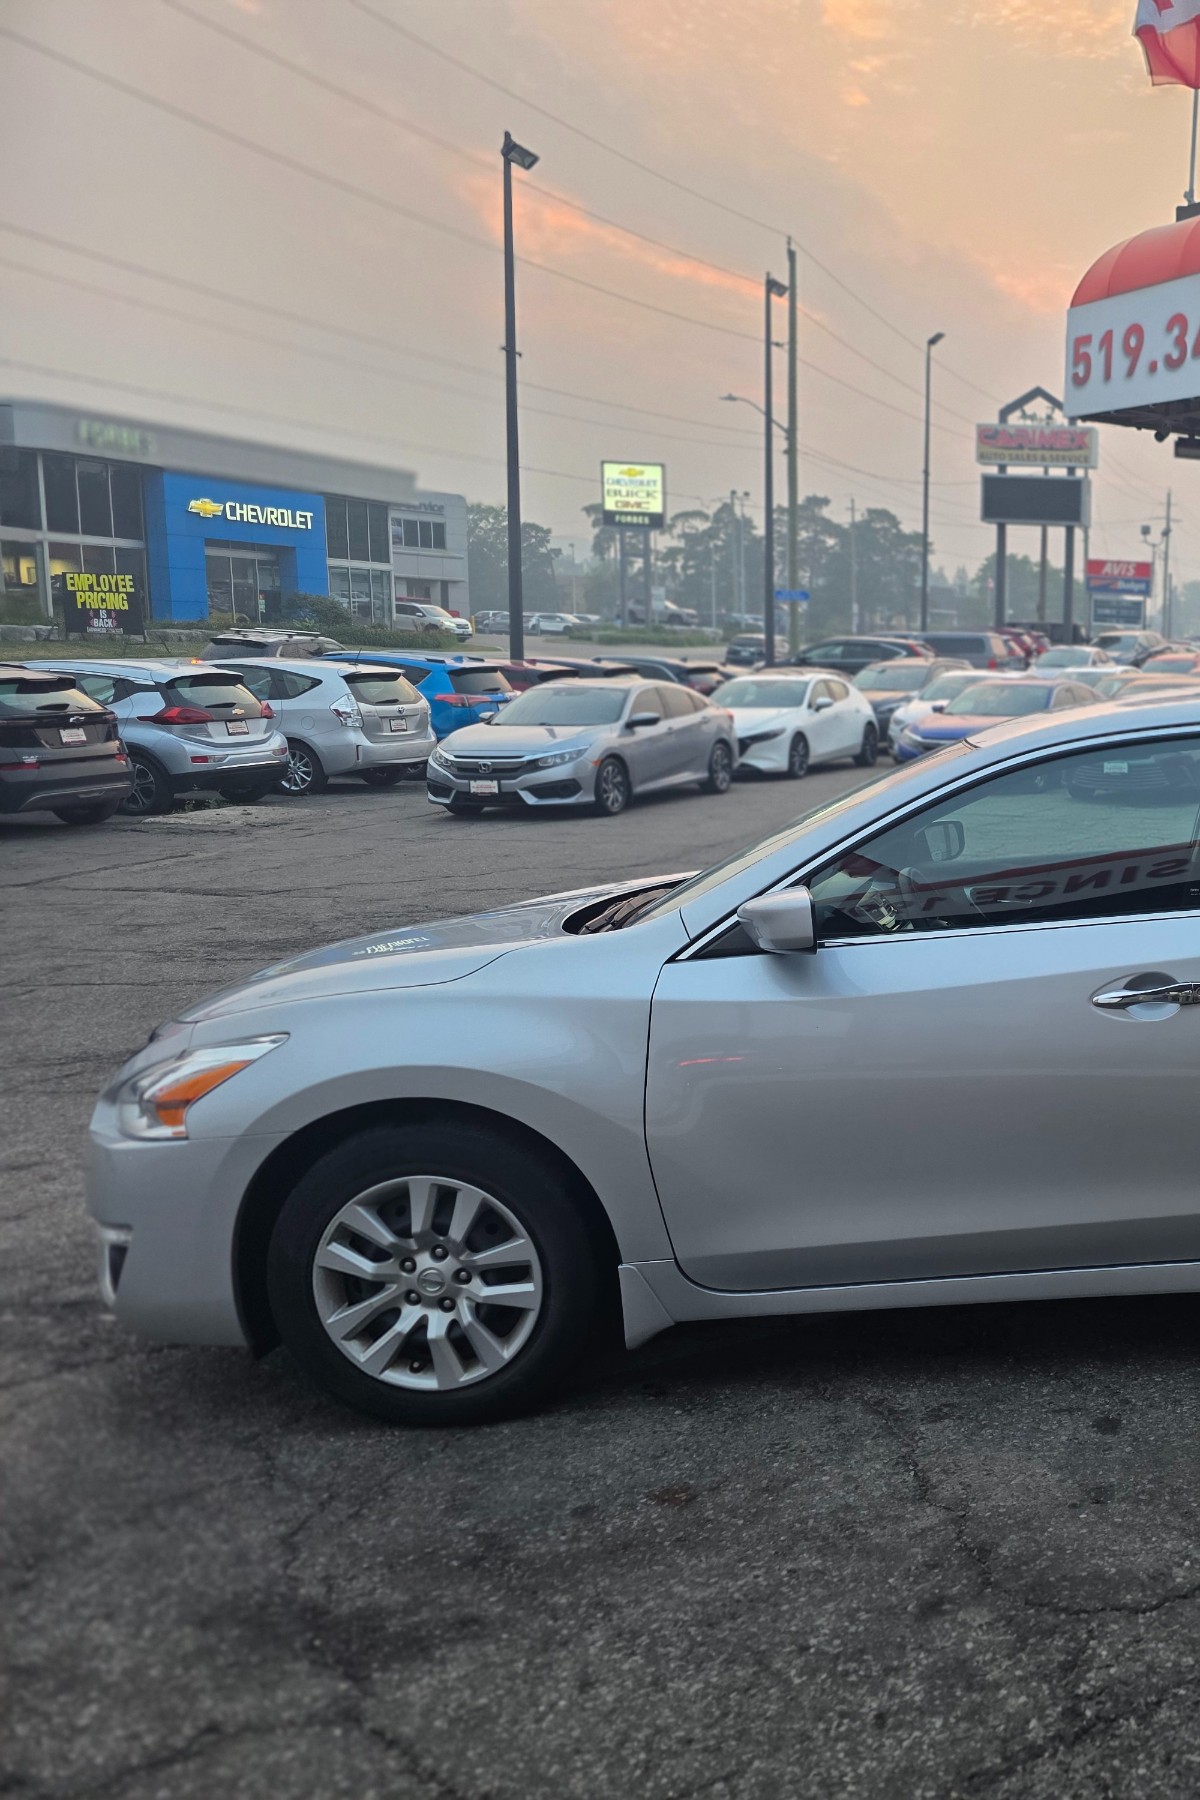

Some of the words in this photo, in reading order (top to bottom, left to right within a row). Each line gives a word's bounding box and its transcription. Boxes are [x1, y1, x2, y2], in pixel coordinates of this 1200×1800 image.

[978, 427, 1090, 450] CARIMEX
[1009, 453, 1038, 462] SALES
[1050, 454, 1089, 463] SERVICE
[606, 488, 658, 500] BUICK
[615, 500, 650, 510] GMC
[225, 501, 313, 530] CHEVROLET
[615, 514, 649, 525] FORBES
[1102, 561, 1136, 577] AVIS
[66, 573, 135, 592] EMPLOYEE
[75, 591, 129, 610] PRICING
[99, 609, 107, 618] IS
[93, 619, 113, 628] BACK
